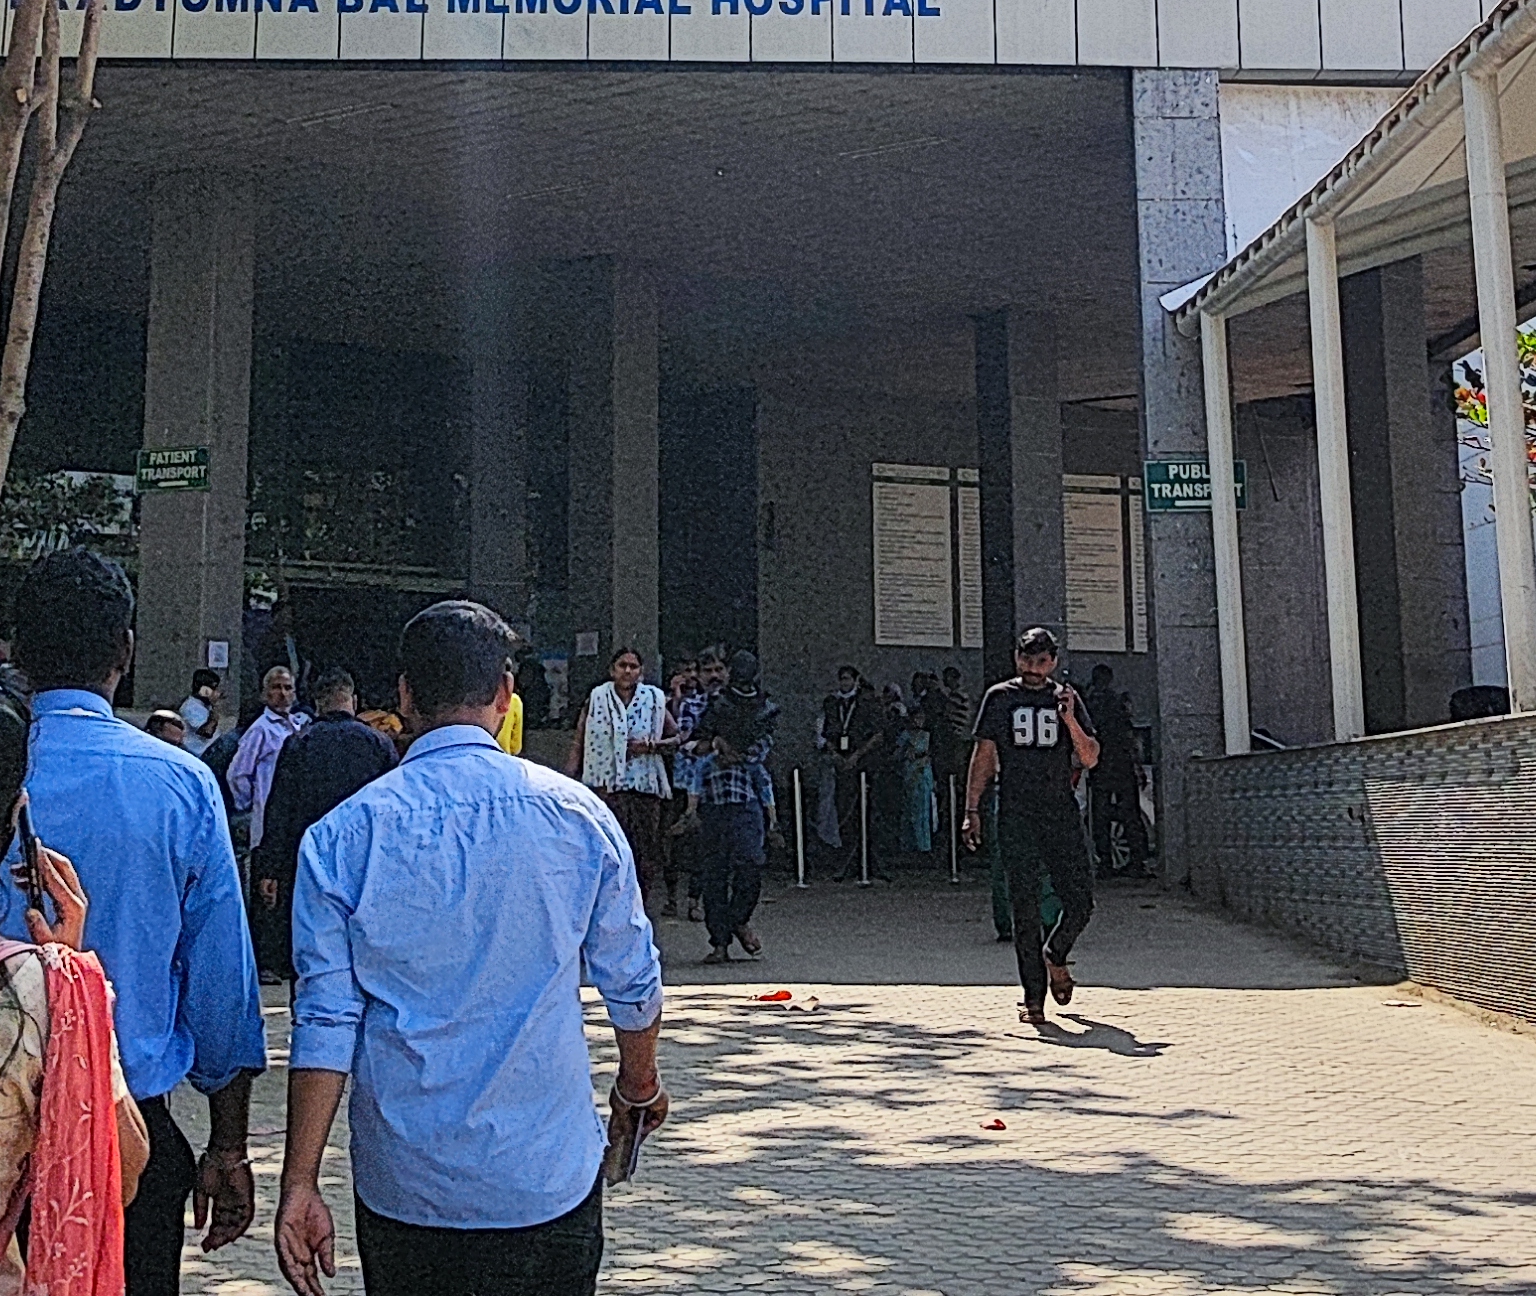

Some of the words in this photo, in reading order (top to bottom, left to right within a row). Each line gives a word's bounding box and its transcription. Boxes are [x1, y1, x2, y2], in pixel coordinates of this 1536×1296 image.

[149, 450, 197, 465] PATIENT
[140, 466, 206, 481] TRANSPORT
[1168, 464, 1211, 480] PUBL
[1150, 483, 1244, 498] TRANSPT
[1012, 706, 1059, 747] 96
